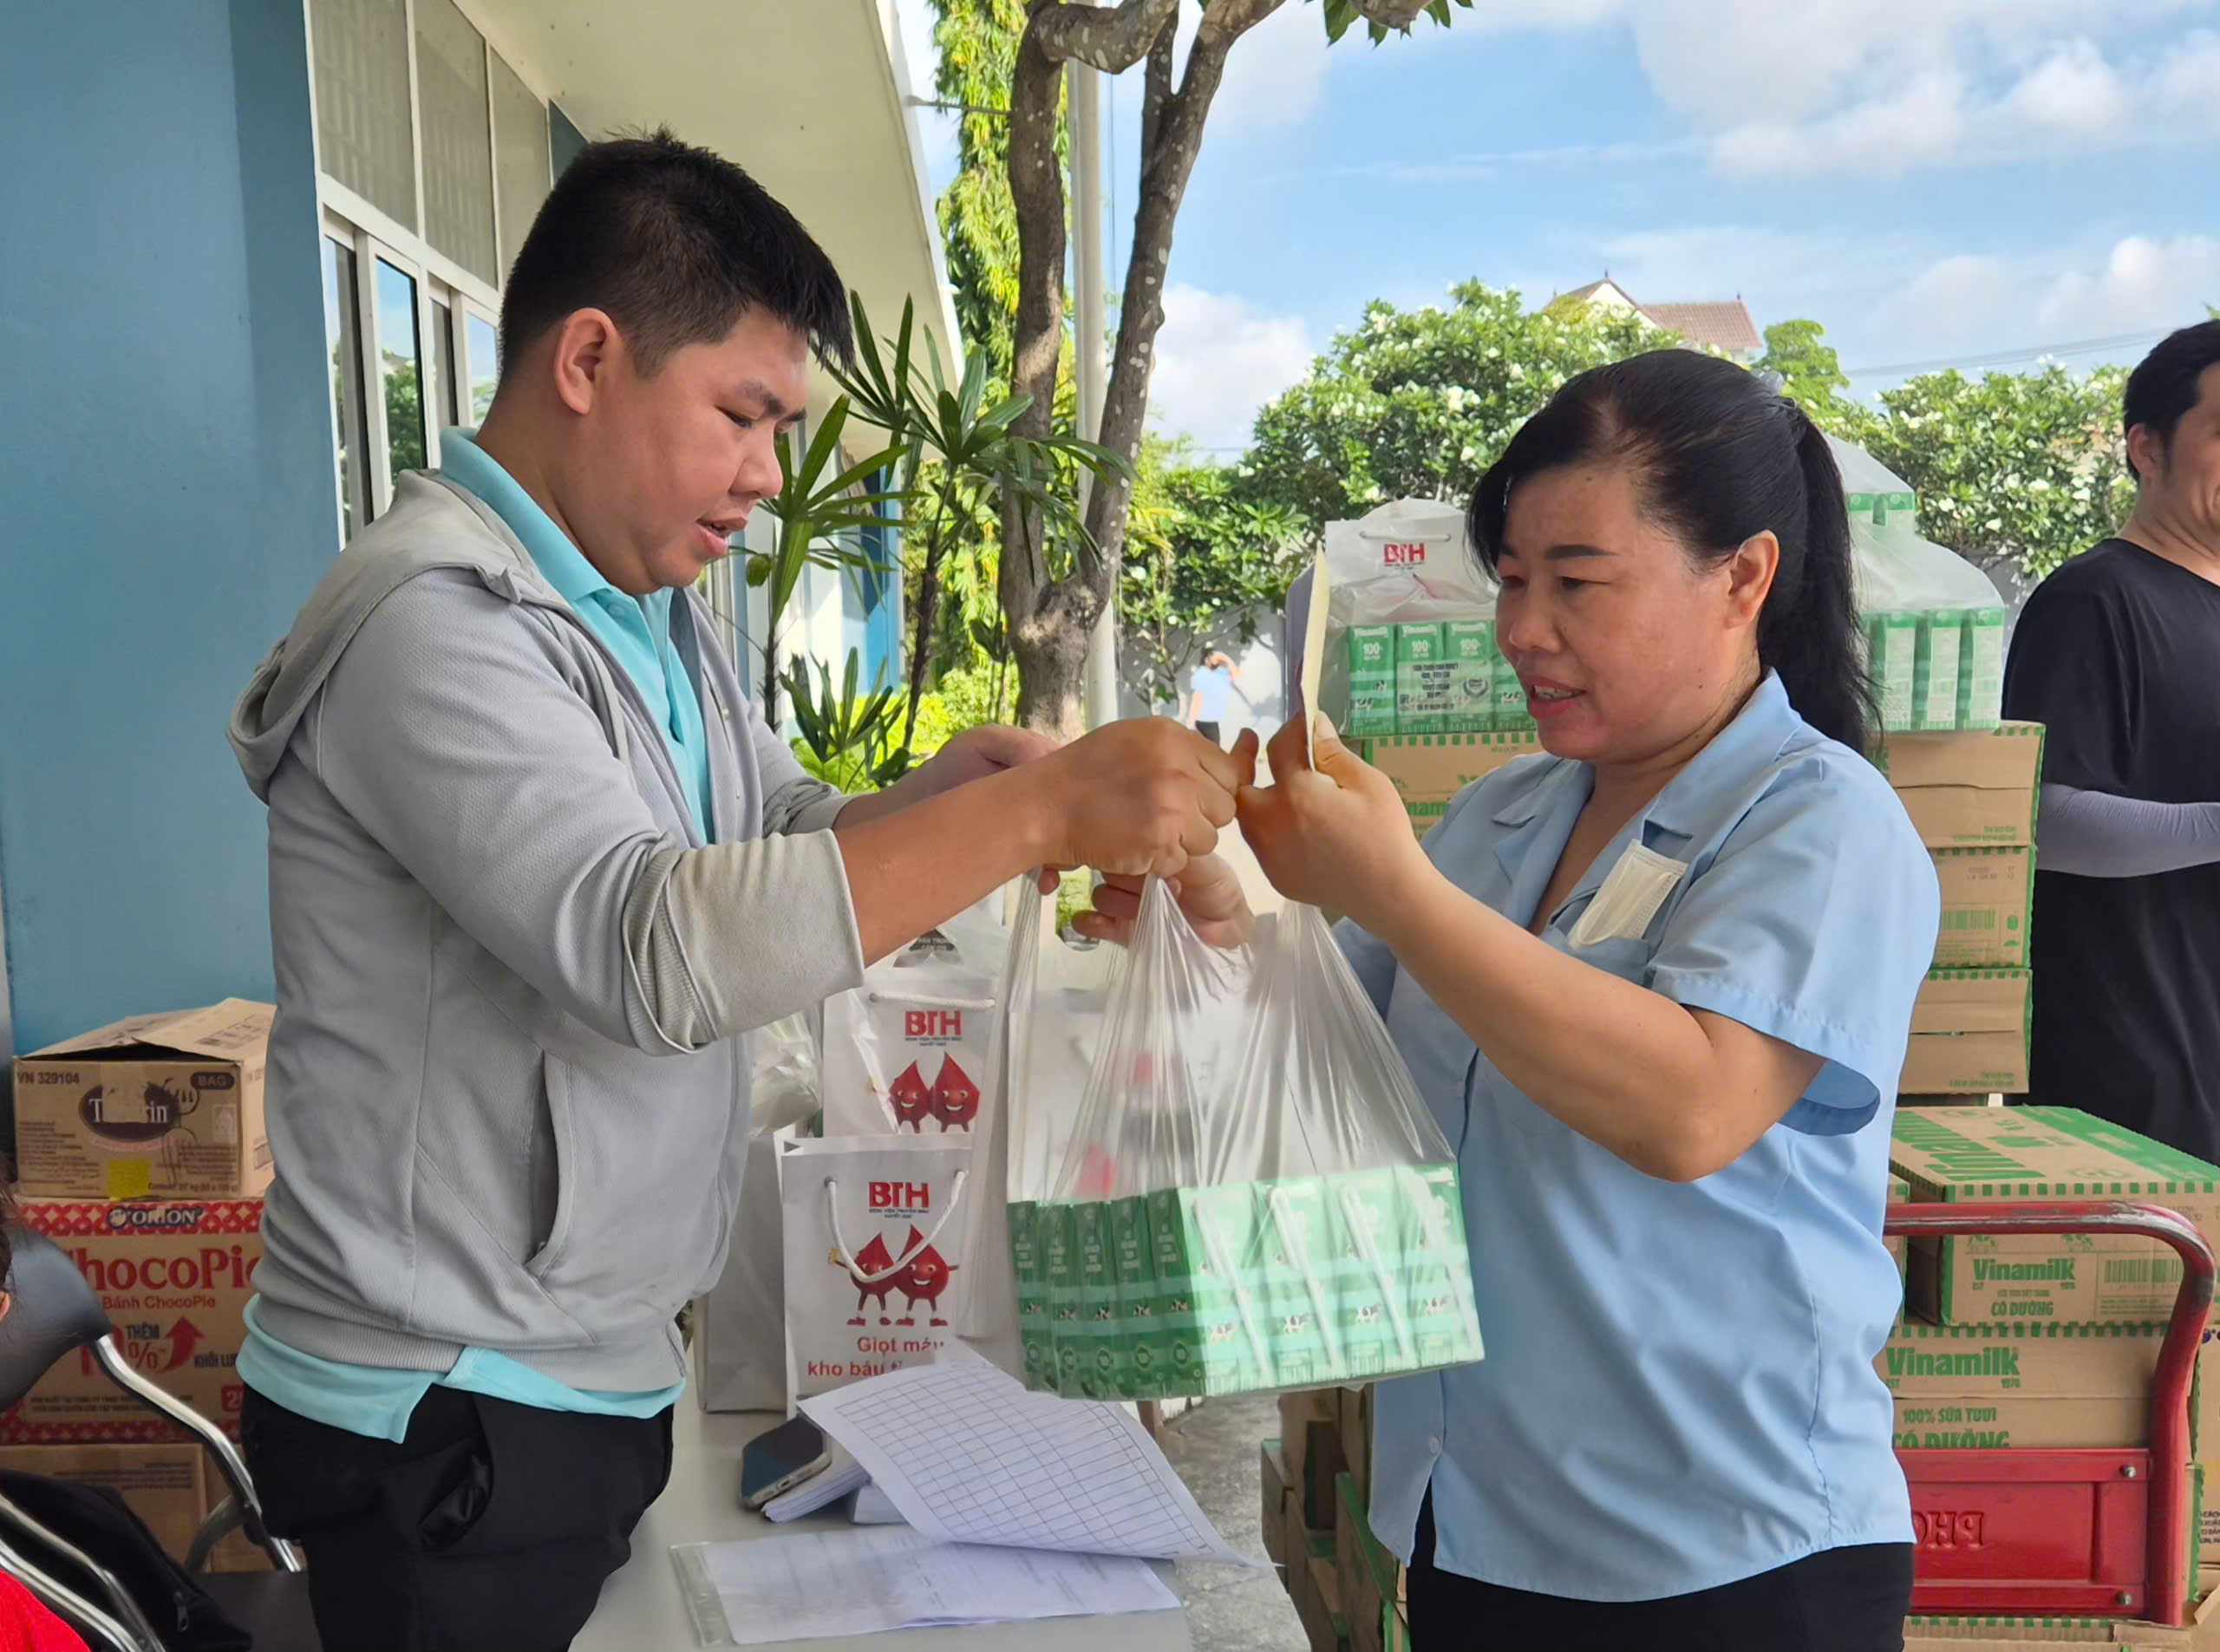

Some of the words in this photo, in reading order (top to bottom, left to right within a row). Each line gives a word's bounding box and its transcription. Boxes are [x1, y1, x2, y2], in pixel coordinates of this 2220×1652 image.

[905, 1011, 962, 1036] BTH
[17, 1072, 35, 1084] VN
[37, 1072, 80, 1084] 329104
[198, 1074, 227, 1086] BAG
[869, 1182, 930, 1207] BTH
[132, 1211, 196, 1226] ORION
[69, 1244, 261, 1291] hocoPi
[1973, 1257, 2076, 1280] Vinamilk
[102, 1295, 140, 1309] Bánh
[144, 1295, 217, 1309] ChocoPie
[126, 1322, 160, 1340] THÊM
[808, 1360, 843, 1376] kho
[1886, 1347, 2020, 1375] Vinamilk
[1903, 1408, 1936, 1423] 100%
